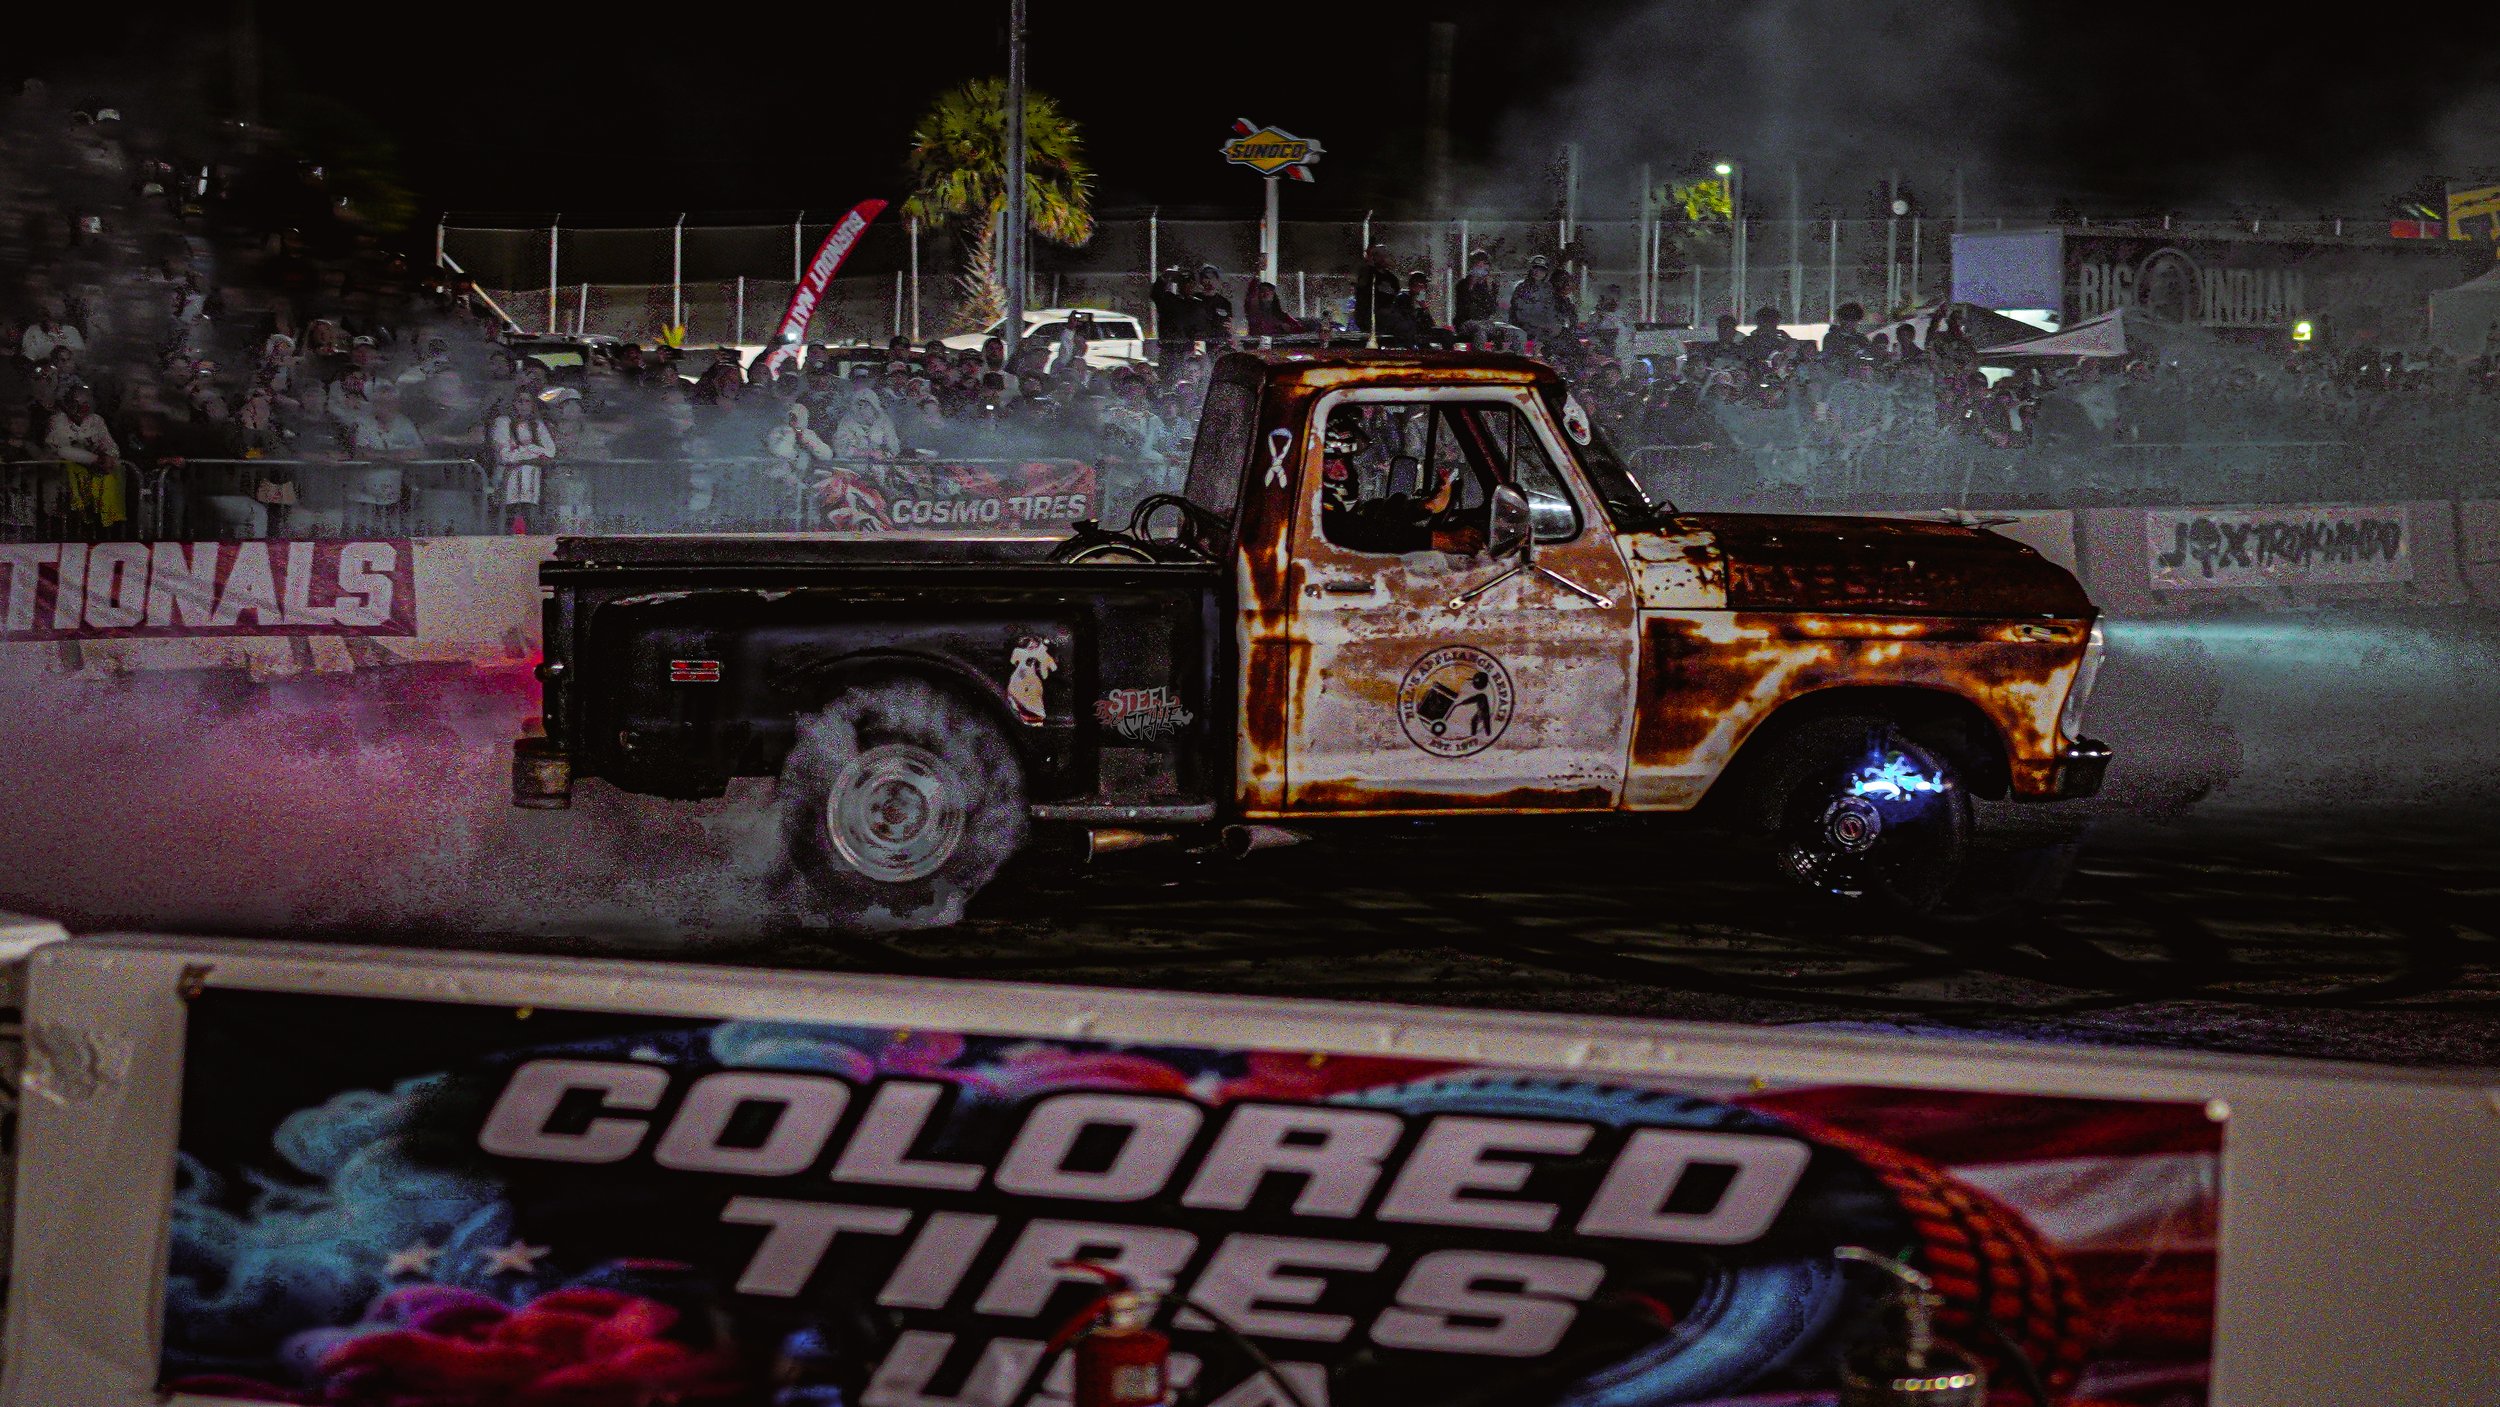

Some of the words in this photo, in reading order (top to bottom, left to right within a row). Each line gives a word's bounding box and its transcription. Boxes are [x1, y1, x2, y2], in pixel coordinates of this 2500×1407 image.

[1231, 143, 1304, 159] SUNOCO
[2080, 263, 2136, 319] BIG
[2200, 267, 2304, 325] INDIAN
[892, 499, 1001, 524] COSMO
[1008, 494, 1088, 520] TIRES
[0, 541, 397, 631] TIONALS
[1108, 686, 1175, 716] STEEL
[1418, 650, 1495, 677] APPLIANCE
[1491, 671, 1509, 723] REPAIR
[1122, 705, 1183, 742] STYLE
[478, 1058, 1813, 1246] COLORED
[720, 1196, 1606, 1357] TIRES
